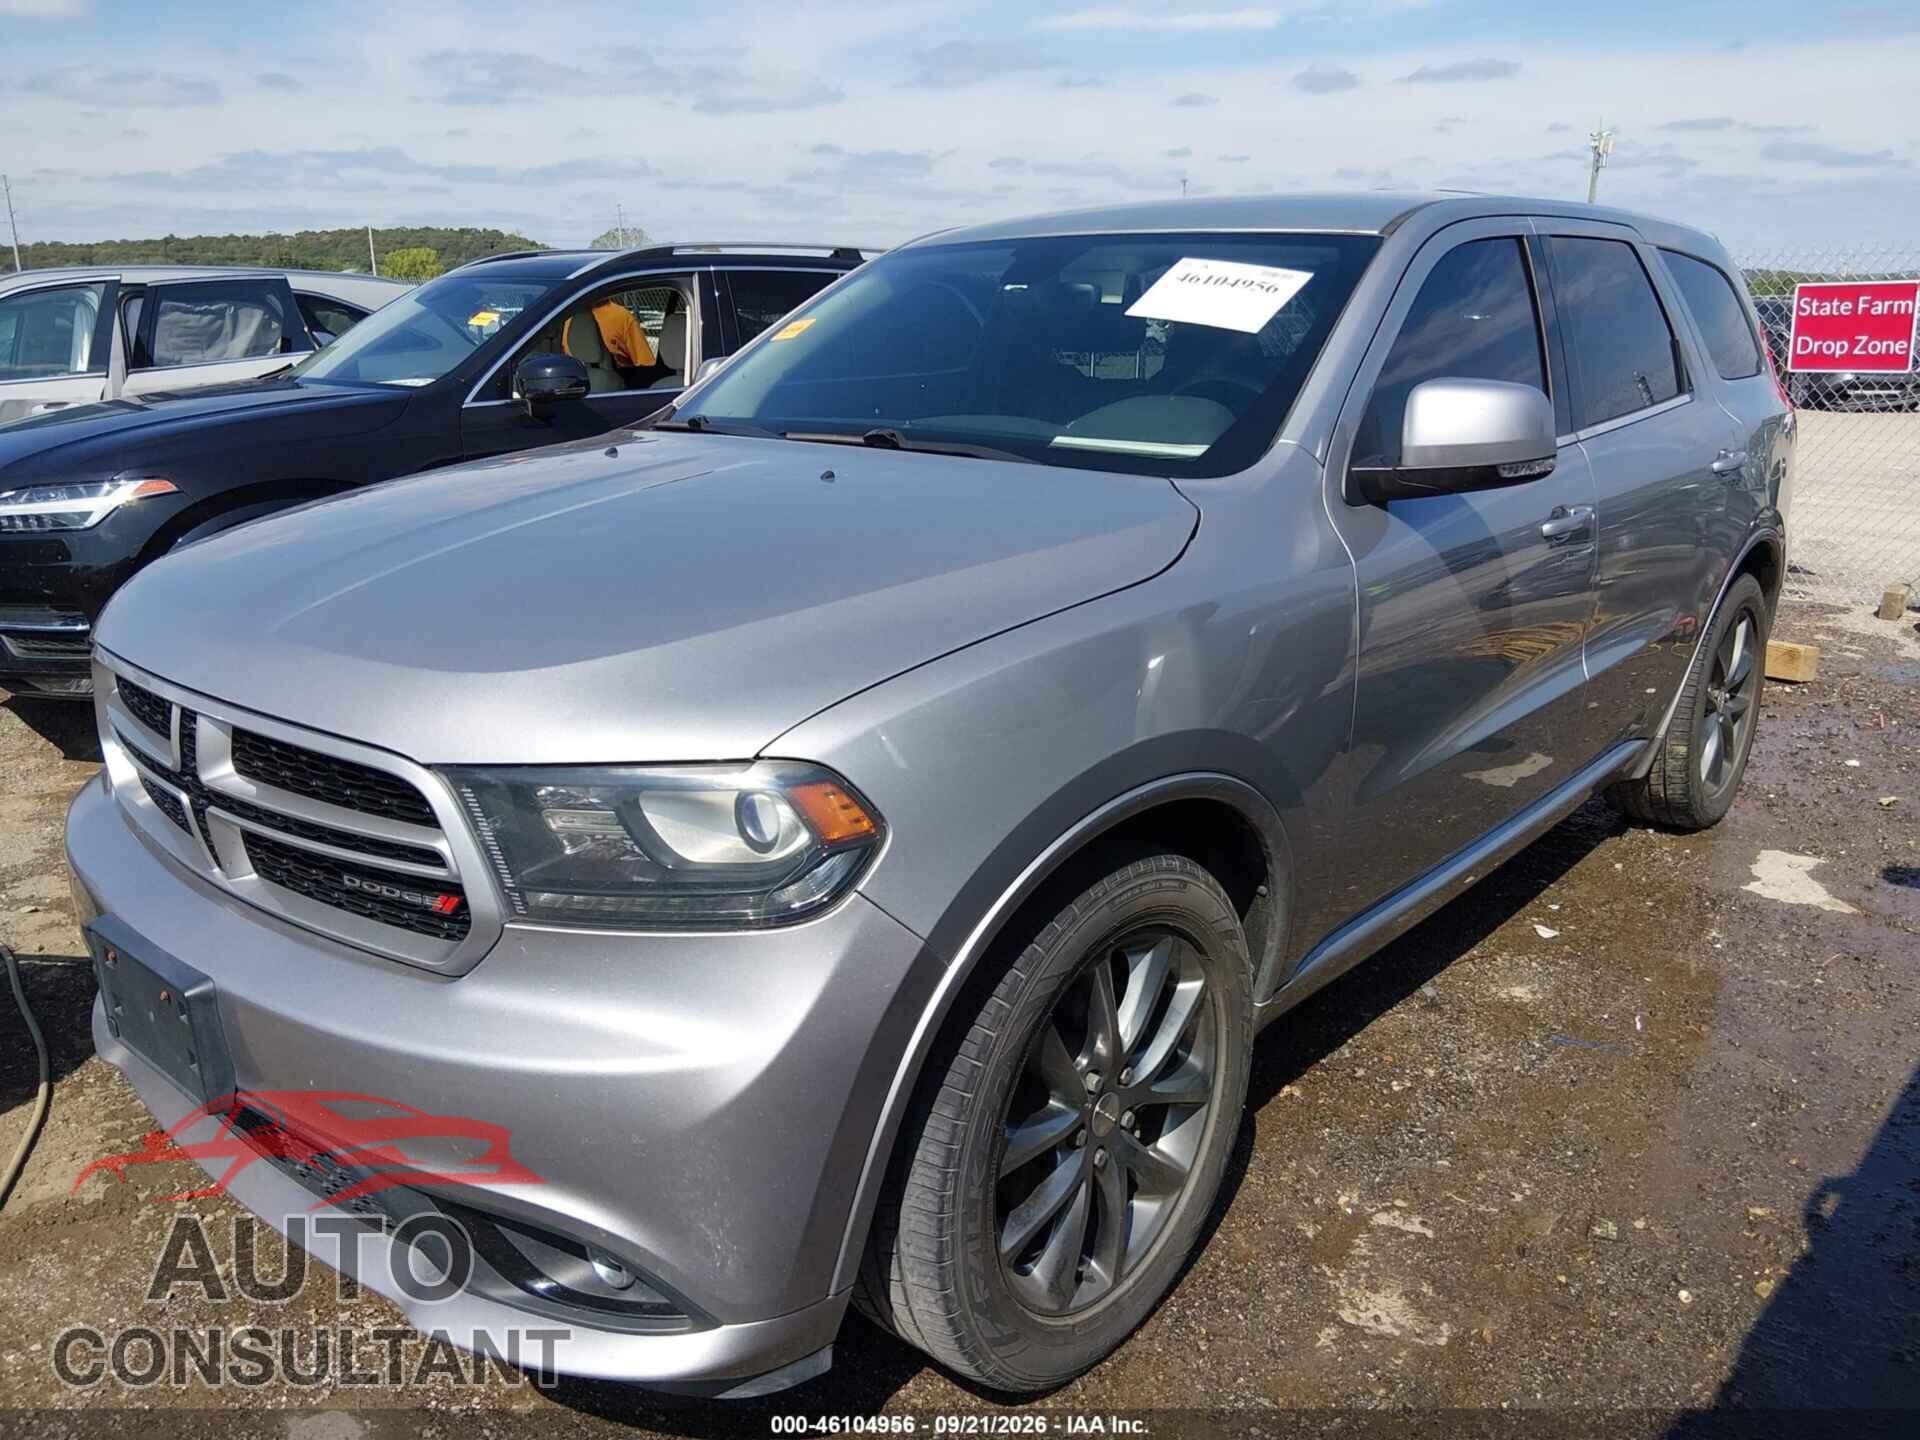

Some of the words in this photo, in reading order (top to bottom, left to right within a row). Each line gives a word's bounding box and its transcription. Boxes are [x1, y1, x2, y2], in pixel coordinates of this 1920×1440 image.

[1798, 297, 1852, 316] State
[1857, 296, 1913, 315] Farm
[1796, 336, 1849, 358] Drop
[1852, 335, 1908, 355] Zone
[343, 874, 443, 912] DODGE
